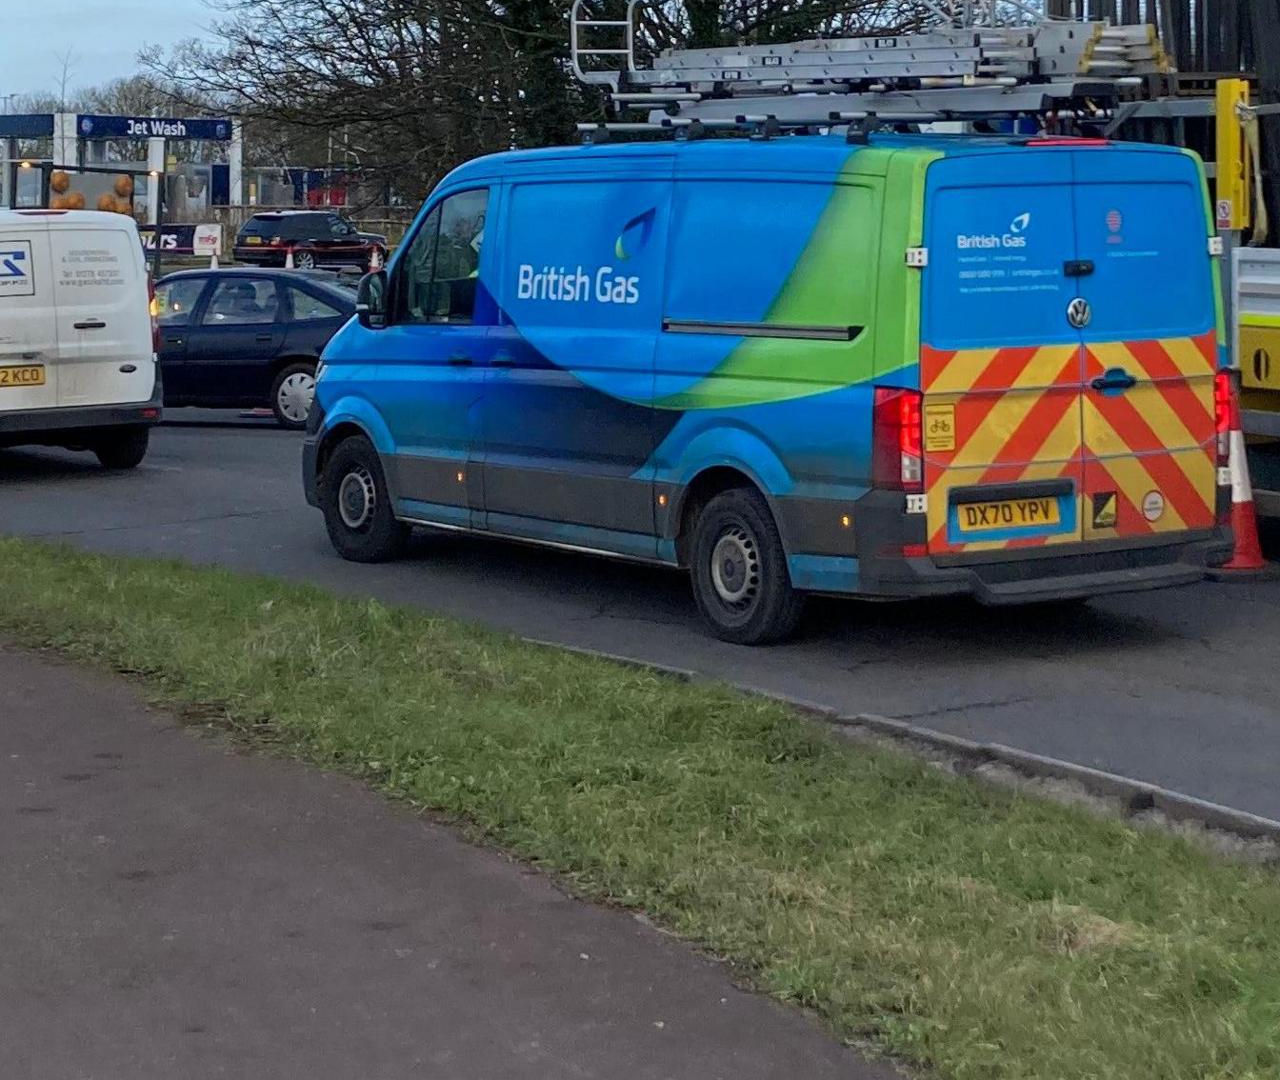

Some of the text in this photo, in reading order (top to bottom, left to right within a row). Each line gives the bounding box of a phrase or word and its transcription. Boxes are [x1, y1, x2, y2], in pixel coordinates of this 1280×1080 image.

[126, 119, 186, 136] Jet Wash
[956, 233, 1026, 249] British Gas
[517, 263, 640, 304] British Gas
[965, 500, 1050, 526] DX70 YPV
